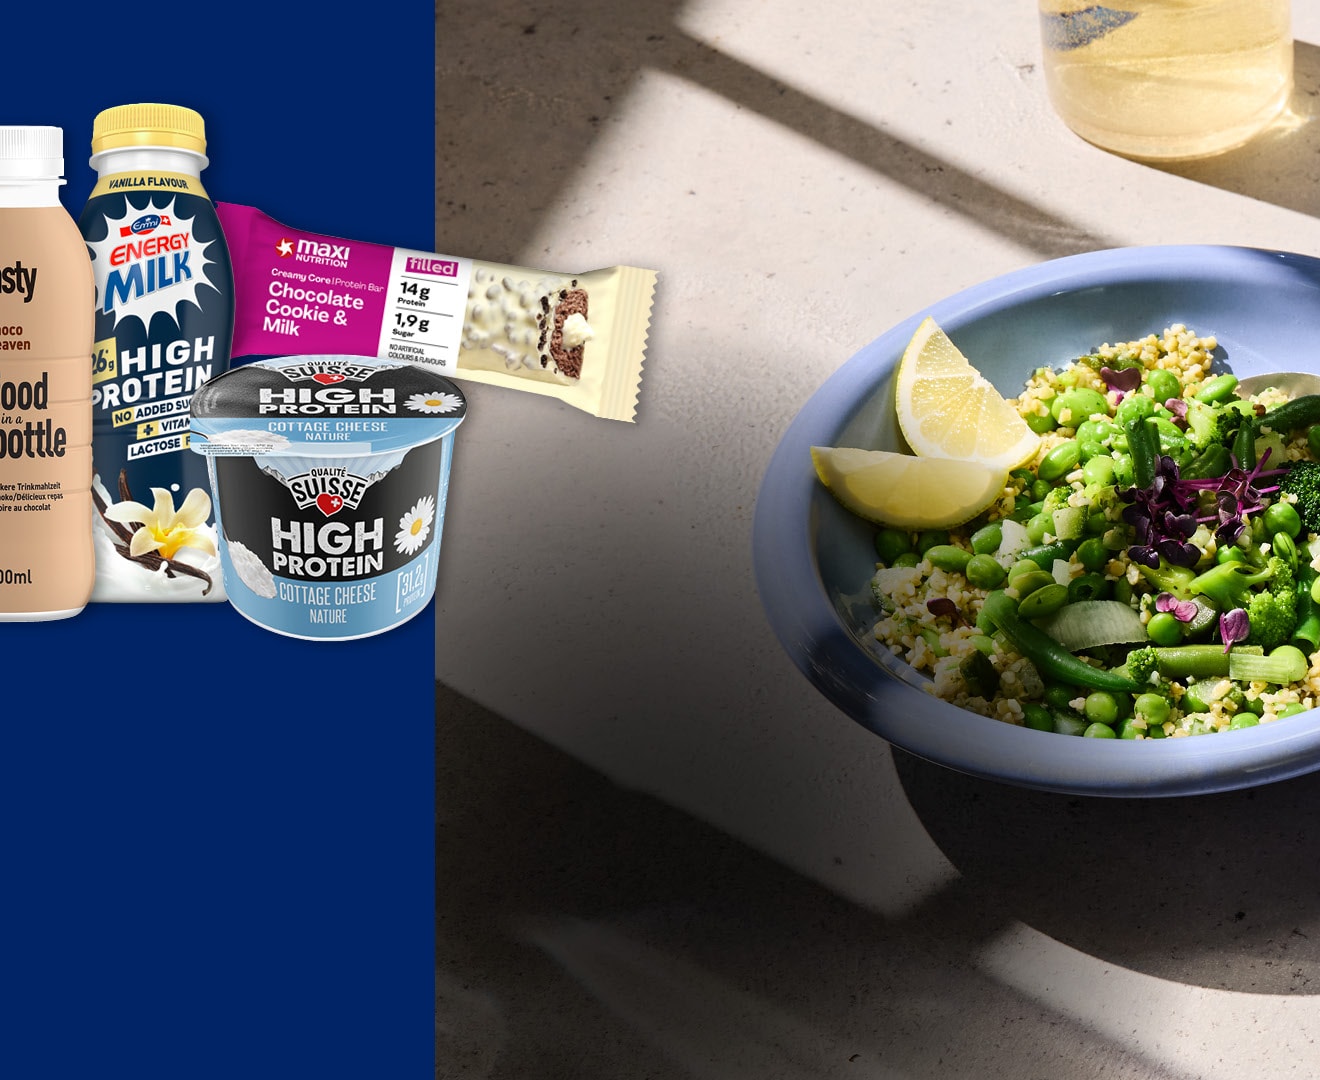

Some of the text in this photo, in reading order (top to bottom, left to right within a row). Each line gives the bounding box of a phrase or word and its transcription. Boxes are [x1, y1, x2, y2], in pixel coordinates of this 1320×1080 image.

[109, 177, 189, 189] VANILLA FLAVOUR
[132, 220, 159, 230] Emmi
[110, 232, 189, 267] ENERGY
[297, 239, 350, 260] maxi
[295, 254, 348, 268] NUTRITION
[409, 258, 455, 275] filled
[103, 251, 192, 314] MILK
[271, 268, 384, 292] Creamy Core Protein Bar
[268, 281, 364, 310] Chocolate
[397, 297, 426, 307] Protein
[266, 299, 347, 326] Cookie &
[263, 316, 301, 337] Milk
[392, 328, 415, 338] Sugar
[121, 336, 215, 376] HIGH
[398, 345, 424, 355] ARTIFICIAL
[388, 351, 413, 361] COLOURS
[419, 356, 446, 366] FLAVOURS
[284, 365, 375, 379] SUISSE
[259, 388, 395, 404] HIGH
[115, 411, 132, 424] NO
[136, 402, 174, 418] ADDED
[259, 404, 396, 414] PROTEIN
[1, 413, 23, 424] in a
[268, 422, 388, 432] COTTAGE CHEESE
[306, 433, 351, 441] NATURE
[131, 438, 180, 457] LACTOSE
[311, 467, 347, 478] QUALITÉ
[17, 482, 61, 491] Trinkmahlzeit
[291, 477, 366, 504] SUISSE
[47, 493, 63, 501] repas
[23, 503, 51, 511] chocolat
[271, 517, 384, 555] HIGH
[272, 551, 384, 577] PROTEIN
[279, 582, 377, 606] COTTAGE CHEESE
[309, 609, 347, 624] NATURE
